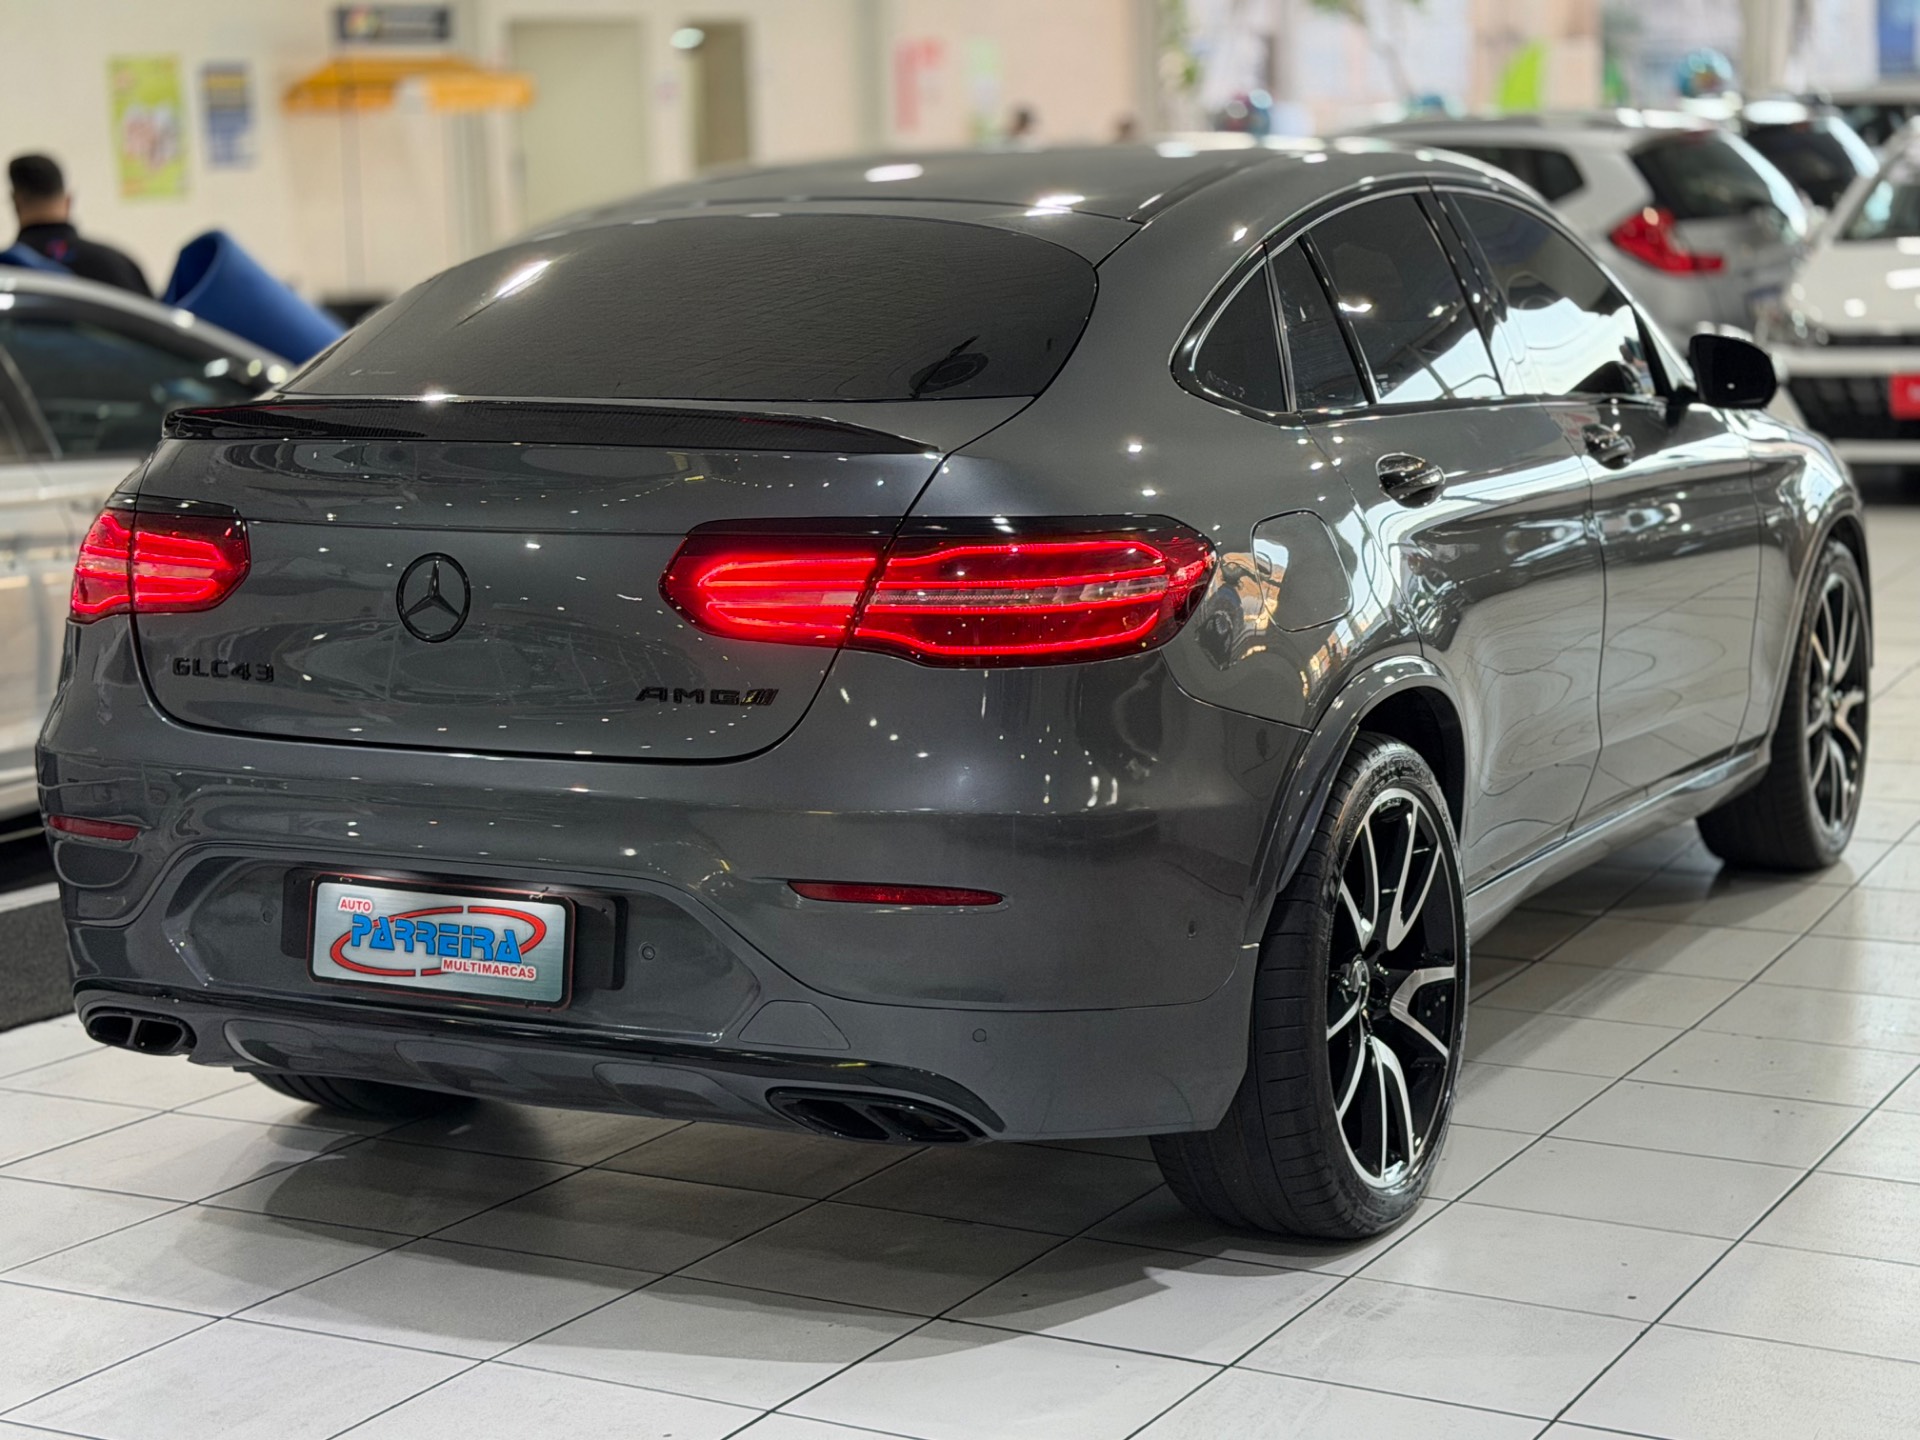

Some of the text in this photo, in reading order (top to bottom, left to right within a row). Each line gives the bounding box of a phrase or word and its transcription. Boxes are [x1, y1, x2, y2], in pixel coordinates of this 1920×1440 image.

[634, 687, 740, 706] AMG
[340, 898, 371, 912] AUTO
[351, 914, 522, 964] PARREIRA
[443, 959, 535, 979] MULTIMARCAS
